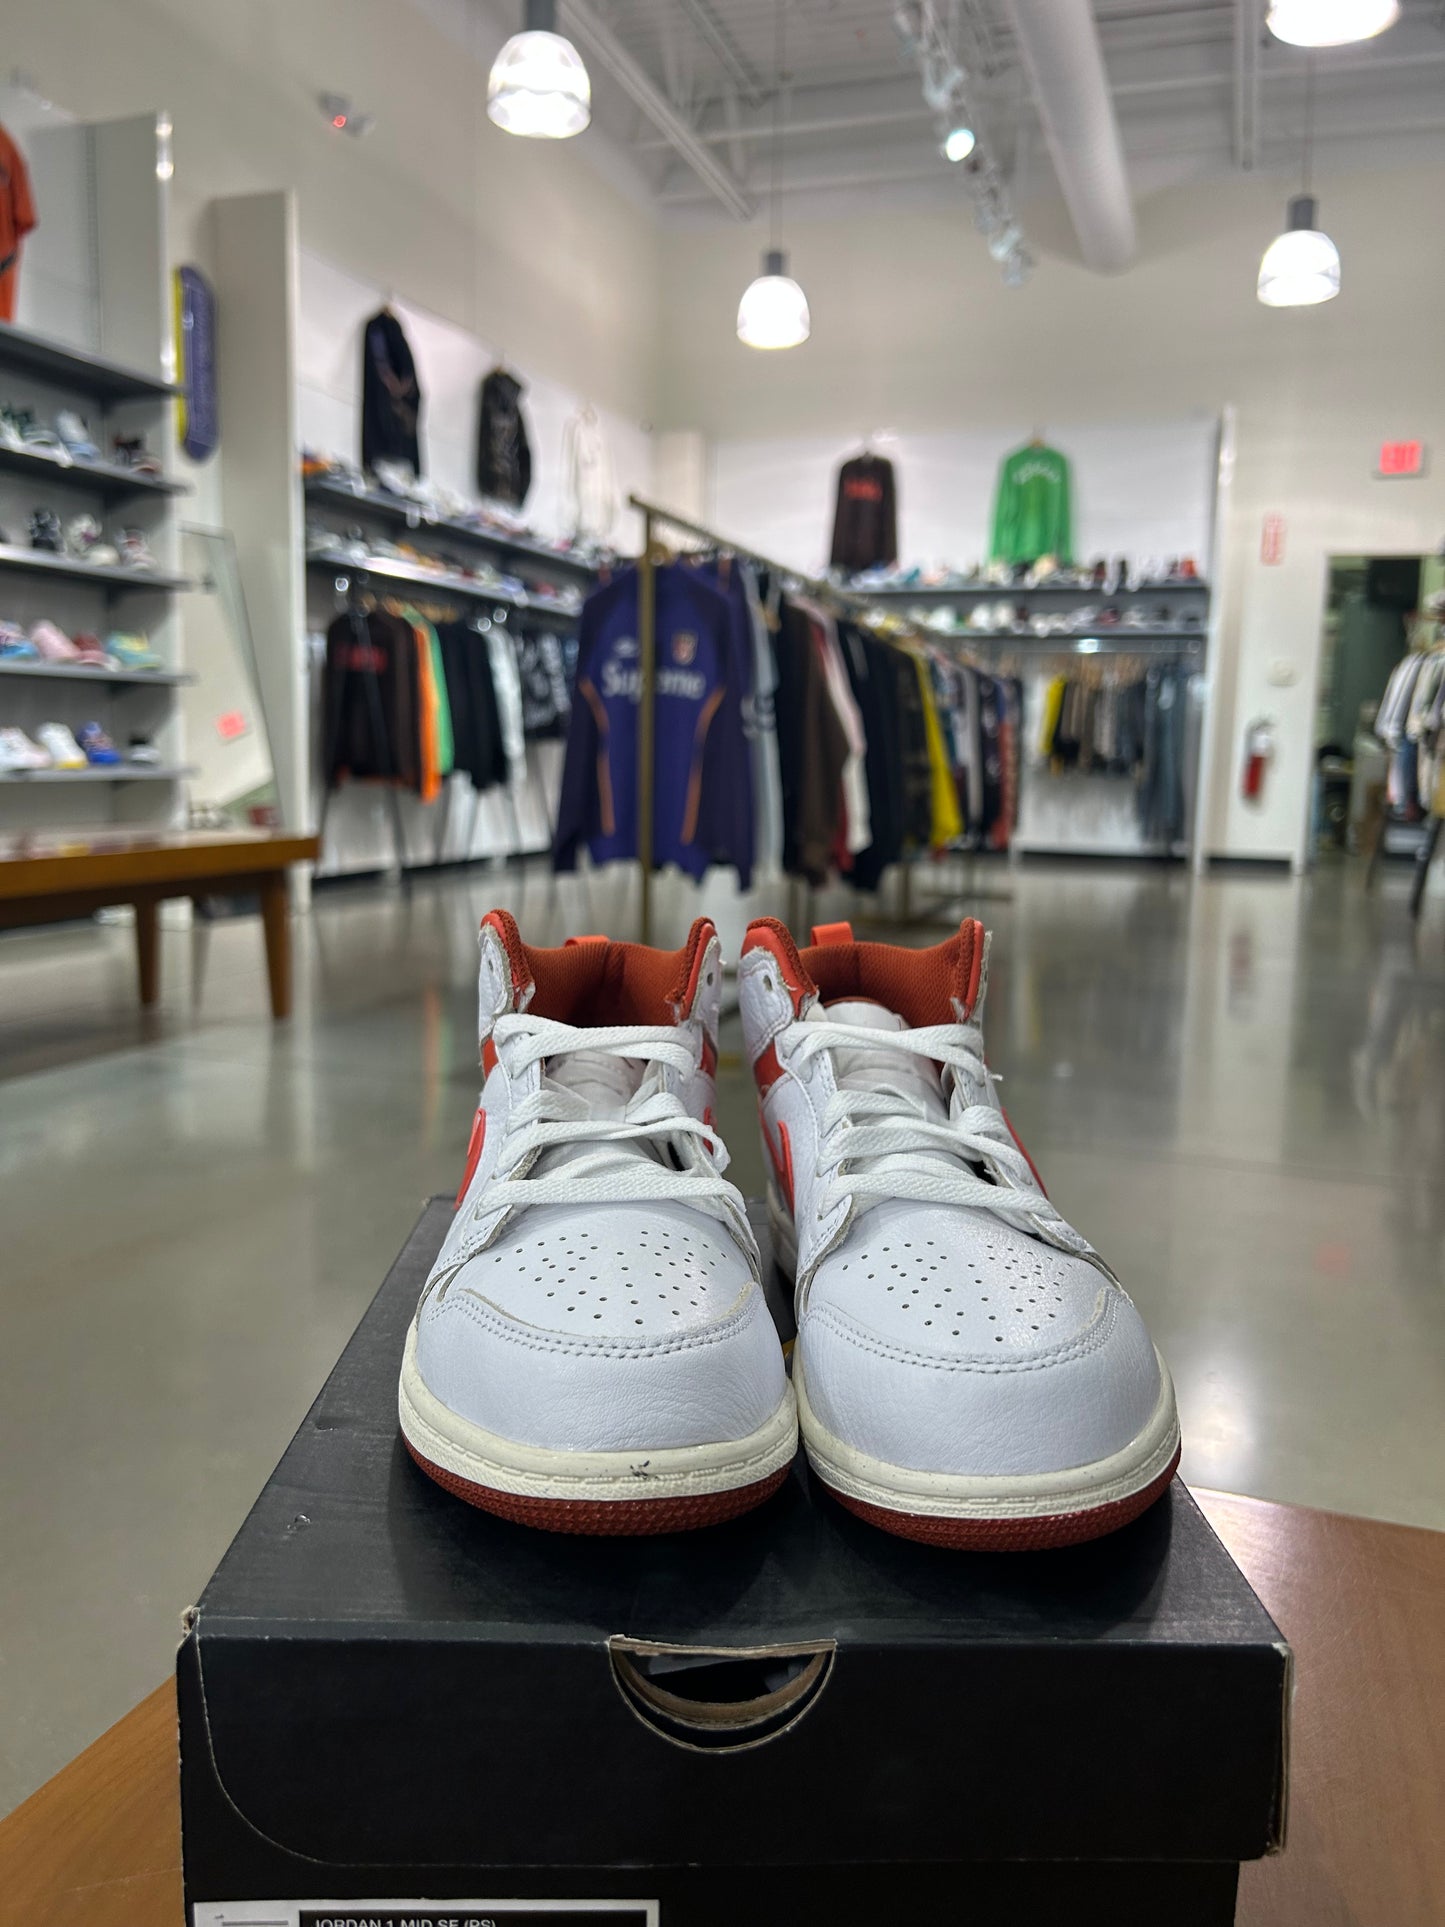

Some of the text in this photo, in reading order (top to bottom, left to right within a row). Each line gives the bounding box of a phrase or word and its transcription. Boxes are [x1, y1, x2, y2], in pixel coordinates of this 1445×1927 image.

[602, 659, 706, 703] Supeme
[315, 1919, 381, 1927] JORDAN
[401, 1919, 433, 1927] MID
